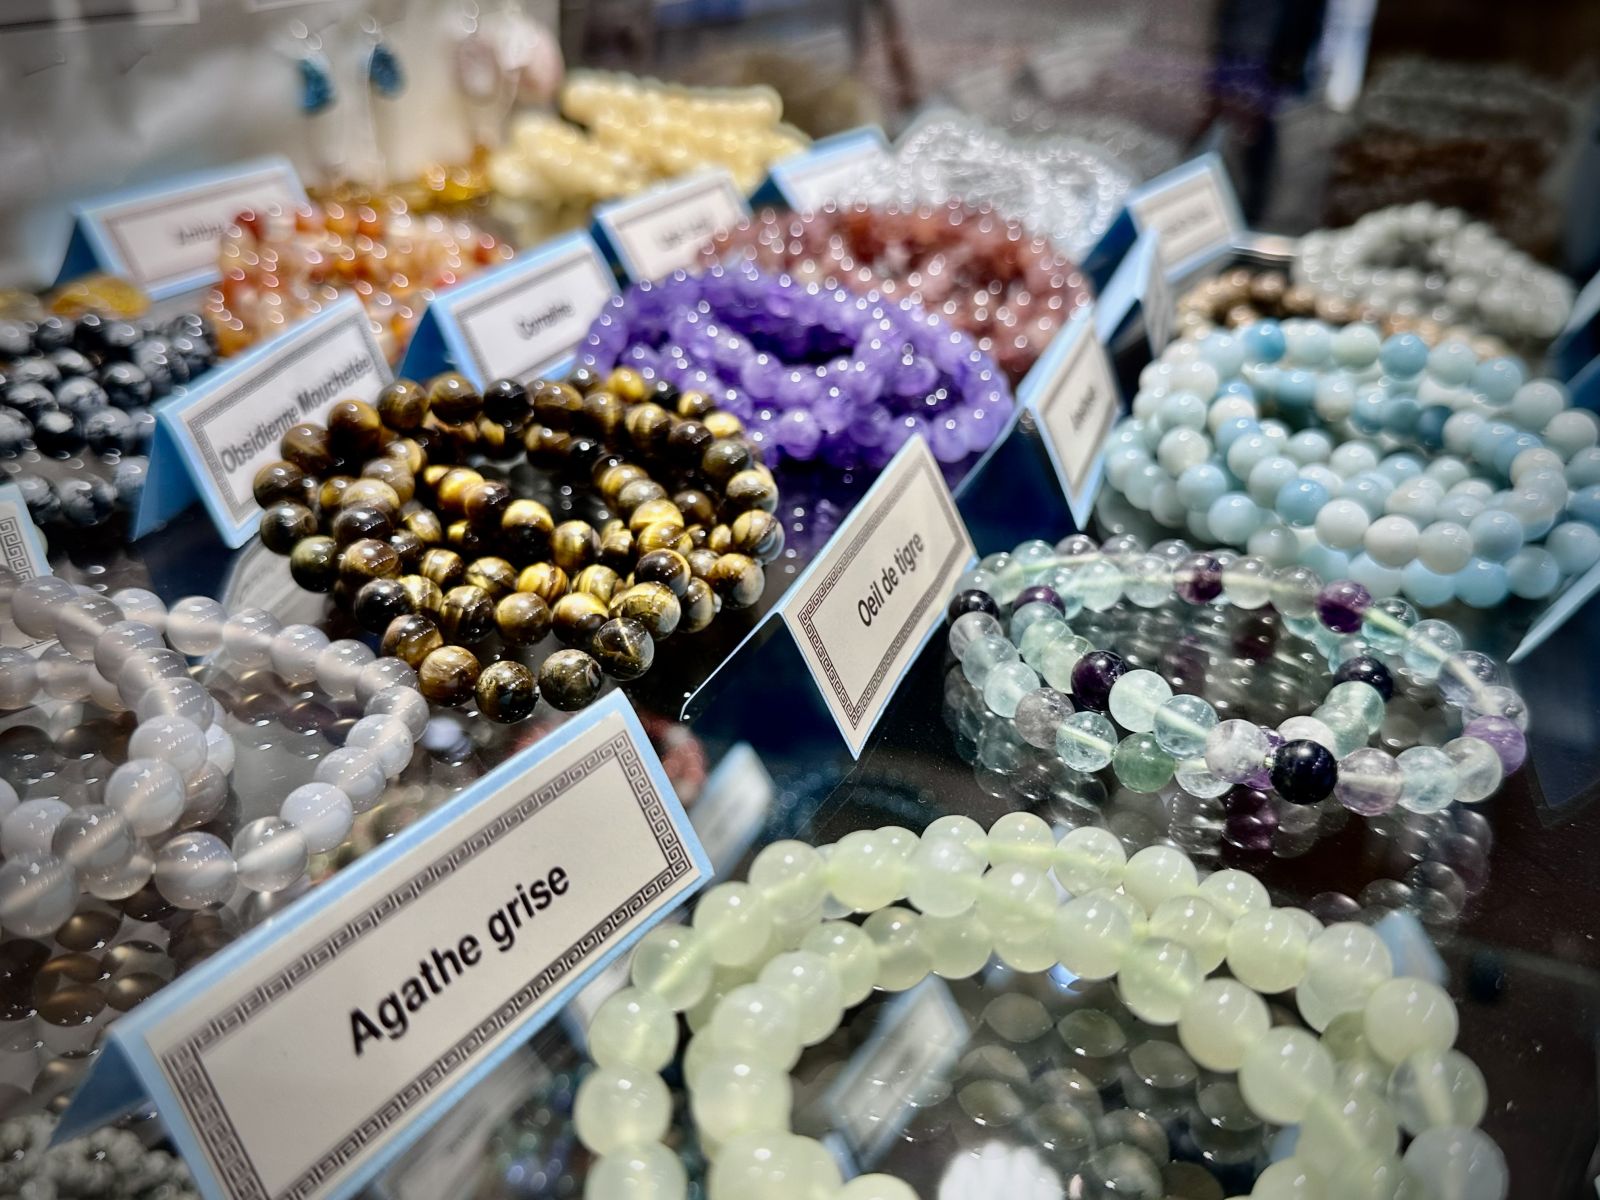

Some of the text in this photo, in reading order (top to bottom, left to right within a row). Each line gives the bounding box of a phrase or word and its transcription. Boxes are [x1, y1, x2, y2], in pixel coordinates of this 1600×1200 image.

[220, 405, 300, 474] Obsidienne
[858, 533, 924, 627] Oeil de tigre
[349, 865, 570, 1057] Agathe grise
